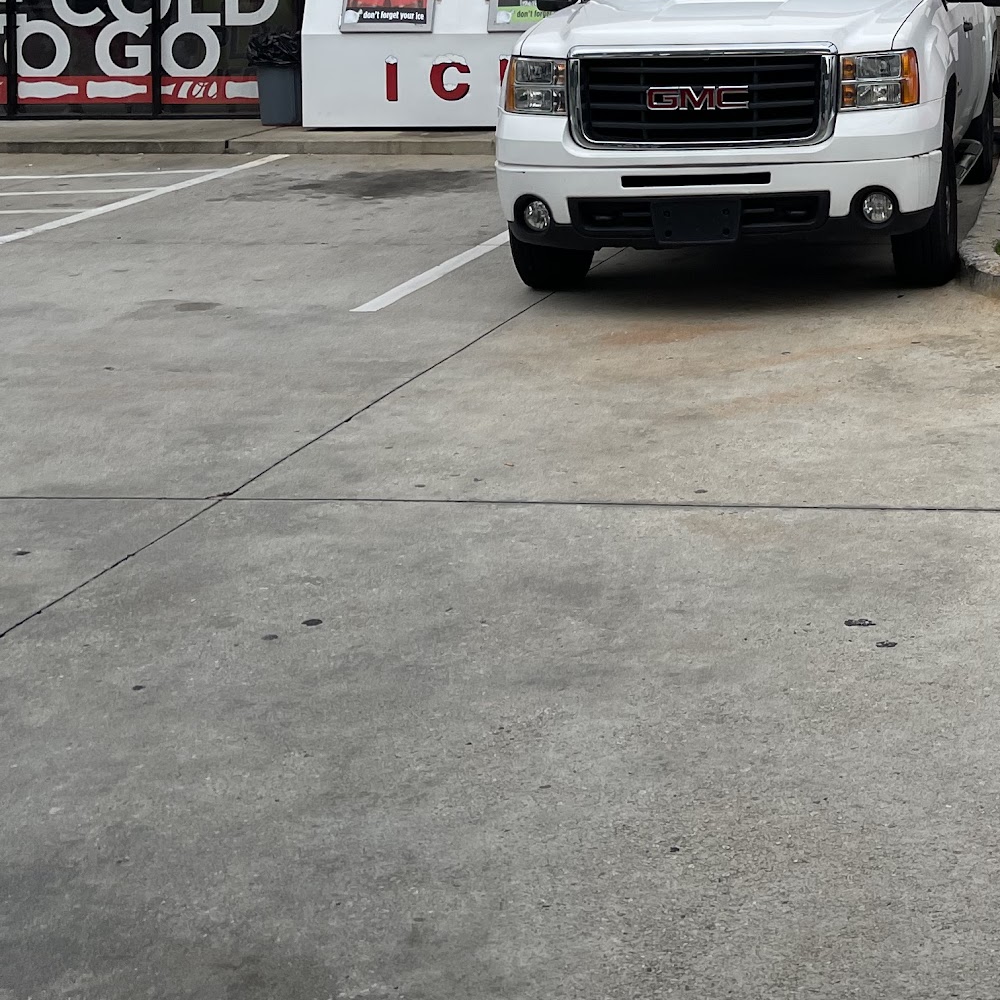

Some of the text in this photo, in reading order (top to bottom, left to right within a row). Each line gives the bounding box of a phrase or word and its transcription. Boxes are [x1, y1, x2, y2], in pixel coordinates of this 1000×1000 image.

[363, 10, 380, 19] don't
[380, 10, 399, 20] forget
[516, 10, 533, 18] don't
[95, 18, 221, 78] GO
[384, 54, 511, 102] IC
[646, 85, 750, 111] GMC
